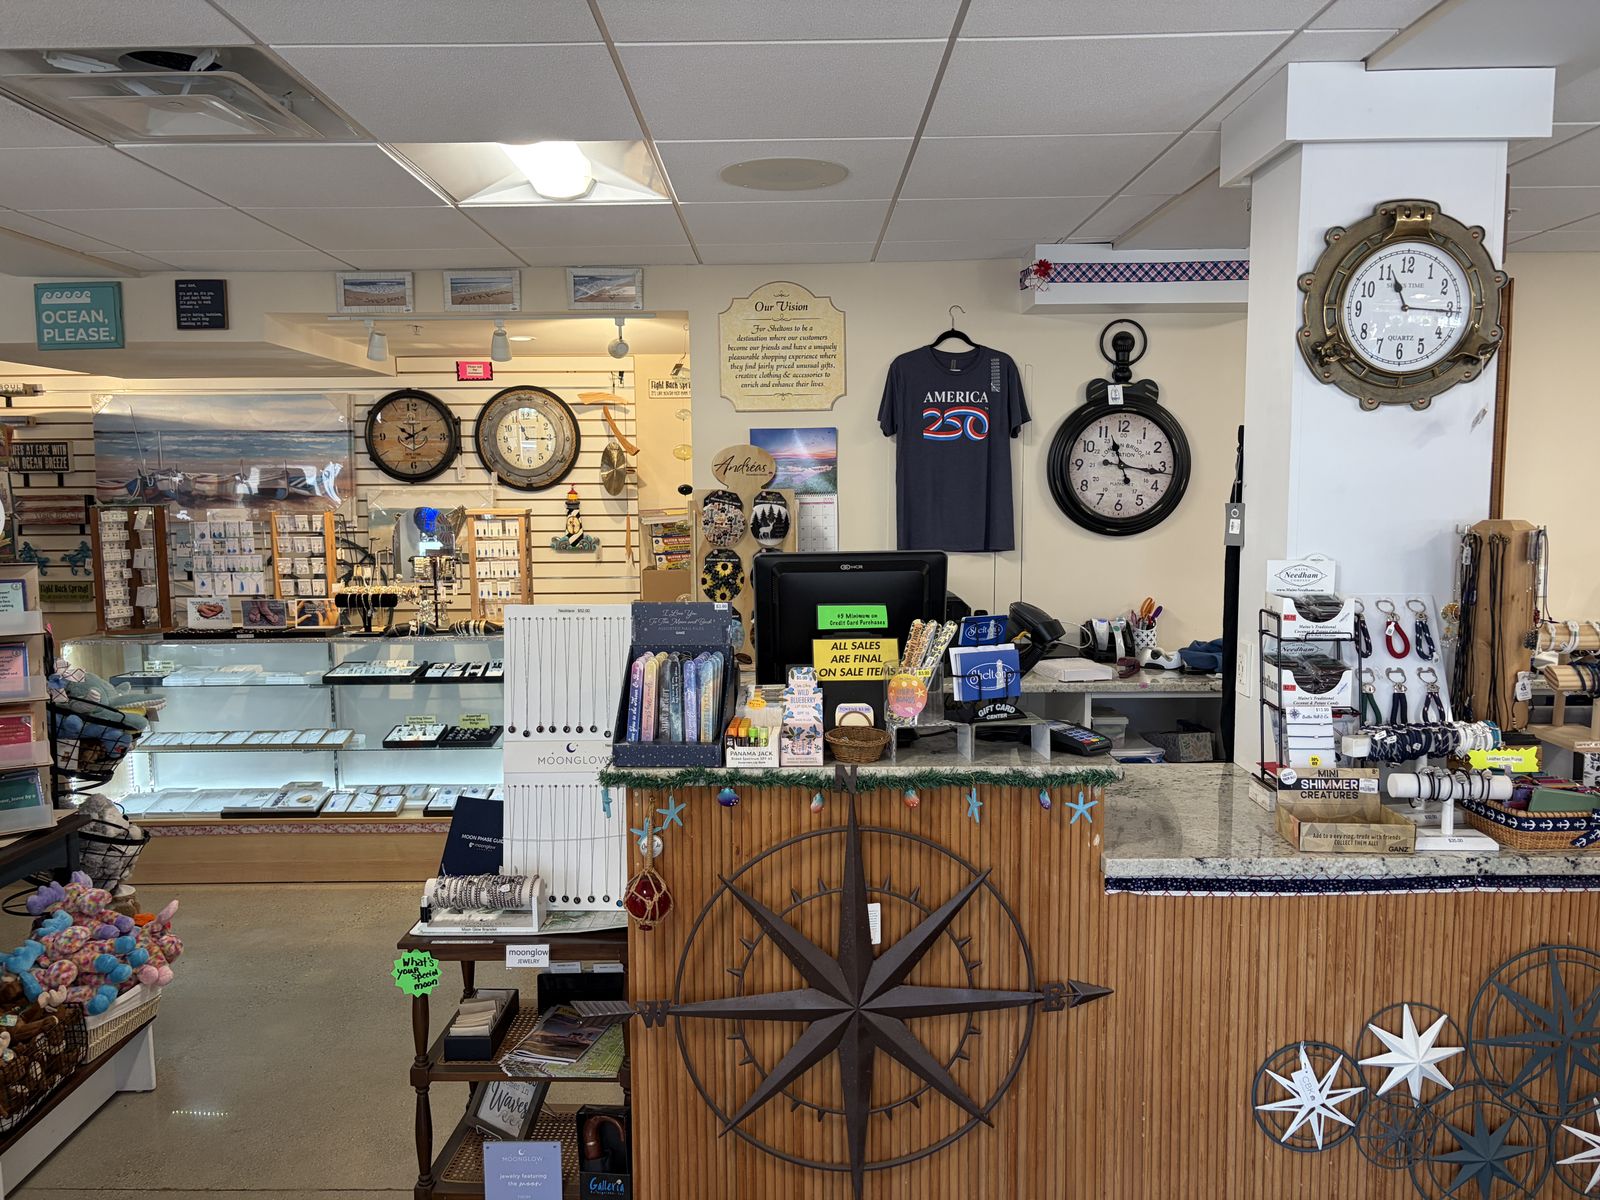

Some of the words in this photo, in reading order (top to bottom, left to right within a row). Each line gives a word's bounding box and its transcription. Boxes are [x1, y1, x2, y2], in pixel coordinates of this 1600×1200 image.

[1401, 256, 1415, 273] 12
[1379, 264, 1391, 280] 11
[1428, 263, 1433, 279] 1
[1361, 281, 1375, 298] 10
[1441, 279, 1448, 295] 2
[754, 301, 774, 312] Our
[776, 301, 808, 311] Vision
[1355, 300, 1362, 317] 9
[1446, 301, 1453, 318] 3
[42, 310, 108, 325] OCEAN,
[44, 327, 115, 342] PLEASE.
[751, 325, 766, 334] For
[768, 324, 793, 332] Sheltons
[1361, 323, 1368, 340] 8
[1435, 326, 1442, 339] 4
[761, 343, 780, 352] friends
[814, 342, 837, 352] uniquely
[1377, 338, 1383, 354] 7
[1396, 343, 1403, 360] 6
[1417, 338, 1424, 354] 5
[728, 353, 760, 362] pleasurable
[762, 353, 787, 362] shopping
[730, 362, 743, 372] they
[744, 362, 757, 371] find
[758, 362, 774, 371] fairly
[776, 362, 795, 371] priced
[759, 371, 782, 380] clothing
[924, 391, 988, 403] AMERICA
[406, 403, 418, 412] 12
[923, 406, 990, 441] 250
[1118, 420, 1130, 432] 12
[380, 433, 386, 441] 9
[440, 433, 446, 441] 3
[1099, 426, 1108, 438] 11
[1142, 427, 1147, 439] 1
[26, 444, 34, 455] AT
[36, 444, 50, 455] EASE
[52, 444, 67, 455] WITH
[1083, 440, 1095, 453] 10
[1125, 443, 1145, 458] BRIDGE
[1154, 441, 1162, 453] 2
[22, 457, 43, 468] OCEAN
[45, 456, 68, 468] BREEZE
[1075, 459, 1083, 471] 9
[1159, 461, 1166, 472] 3
[1080, 480, 1088, 491] 8
[1151, 480, 1159, 492] 4
[1096, 493, 1104, 505] 7
[1136, 494, 1144, 506] 5
[1114, 500, 1122, 511] 6
[685, 609, 698, 618] You
[831, 642, 848, 651] ALL
[851, 641, 881, 650] SALES
[831, 655, 851, 663] ARE
[854, 655, 883, 663] FINAL
[819, 668, 837, 677] ON
[840, 668, 864, 676] SALE
[867, 667, 896, 676] ITEMS
[978, 704, 994, 717] GIFT
[996, 703, 1015, 714] CARD
[538, 755, 609, 765] MOONGLOW
[1318, 769, 1338, 777] MINI
[1301, 779, 1358, 789] SHIMMER
[1301, 791, 1359, 799] CREATURES
[509, 949, 549, 957] moonglow
[403, 957, 434, 967] What's
[397, 967, 420, 980] your
[411, 969, 438, 982] special
[414, 979, 438, 990] moon
[489, 1081, 530, 1120] Waves
[522, 1172, 547, 1180] featuring
[590, 1177, 624, 1193] Galleria
